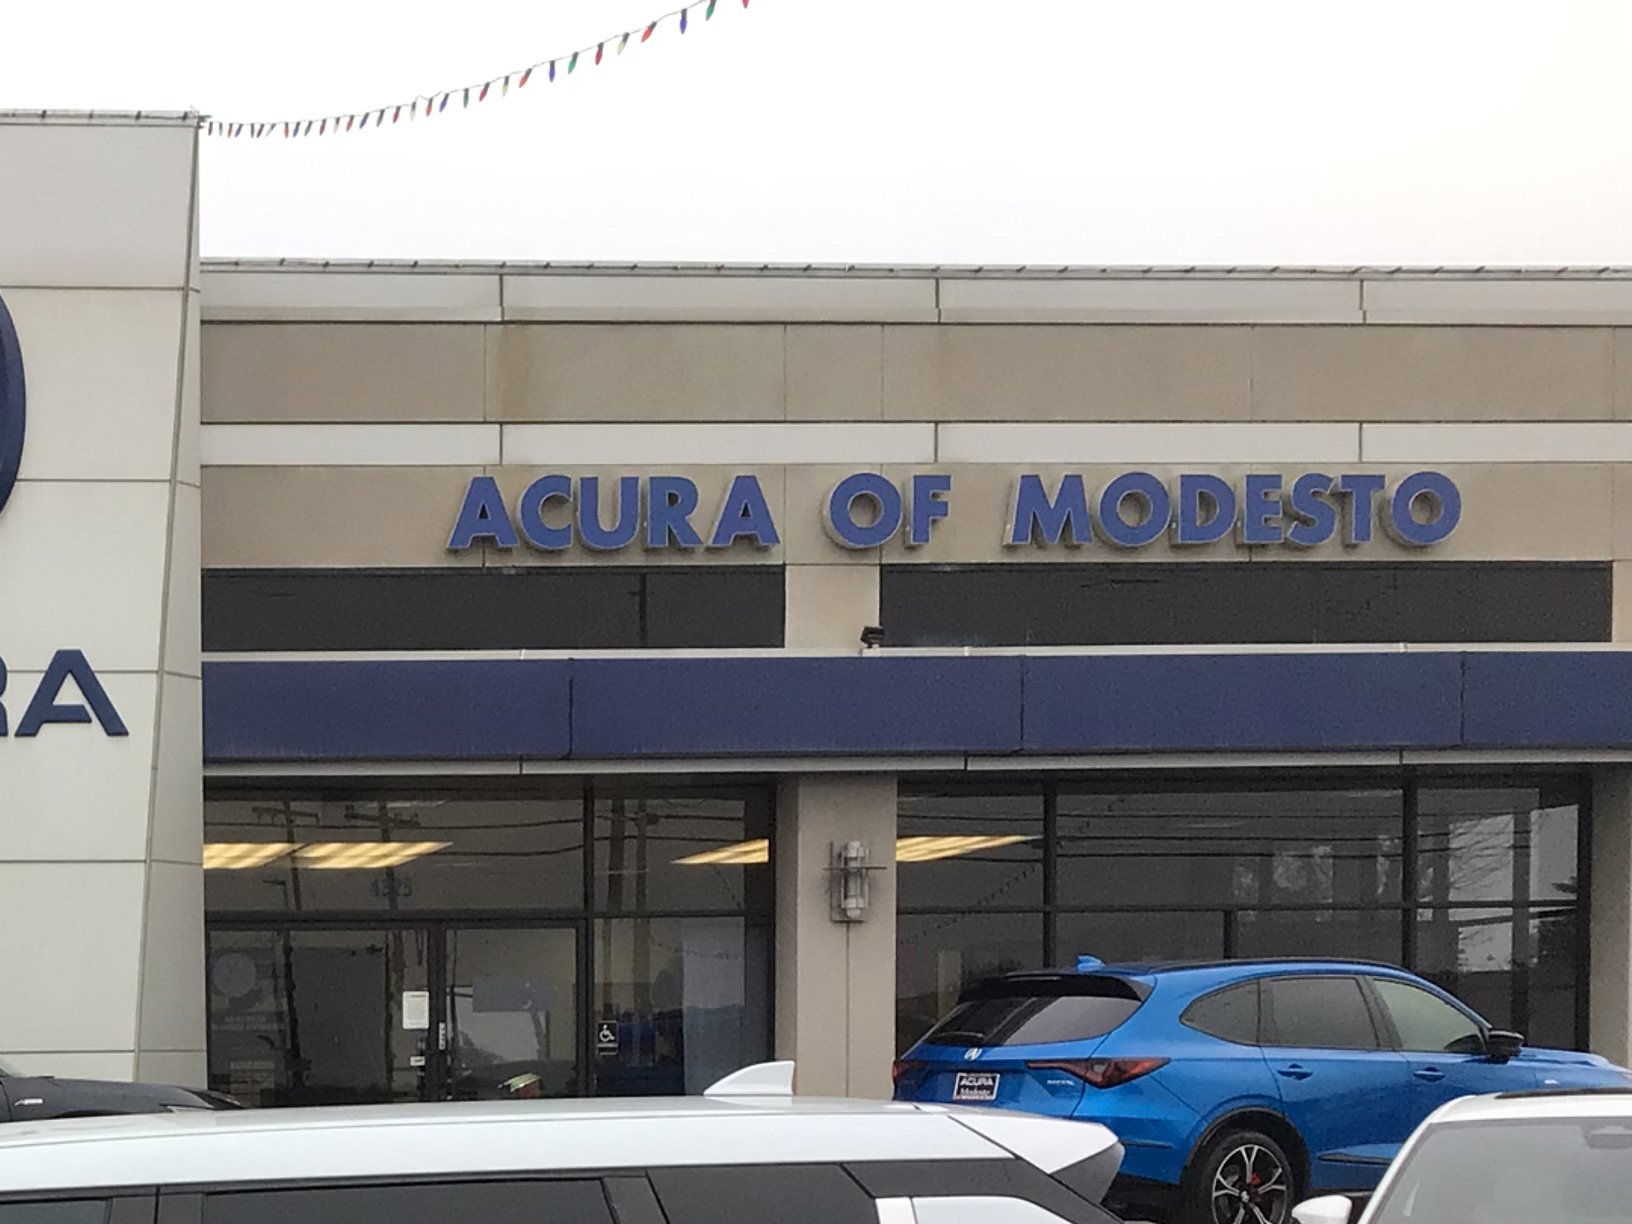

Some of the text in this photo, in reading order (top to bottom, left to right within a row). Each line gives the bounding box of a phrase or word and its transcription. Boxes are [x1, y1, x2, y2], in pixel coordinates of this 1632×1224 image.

[448, 472, 1461, 548] ACURA OF MODESTO
[960, 1077, 994, 1086] ACURA
